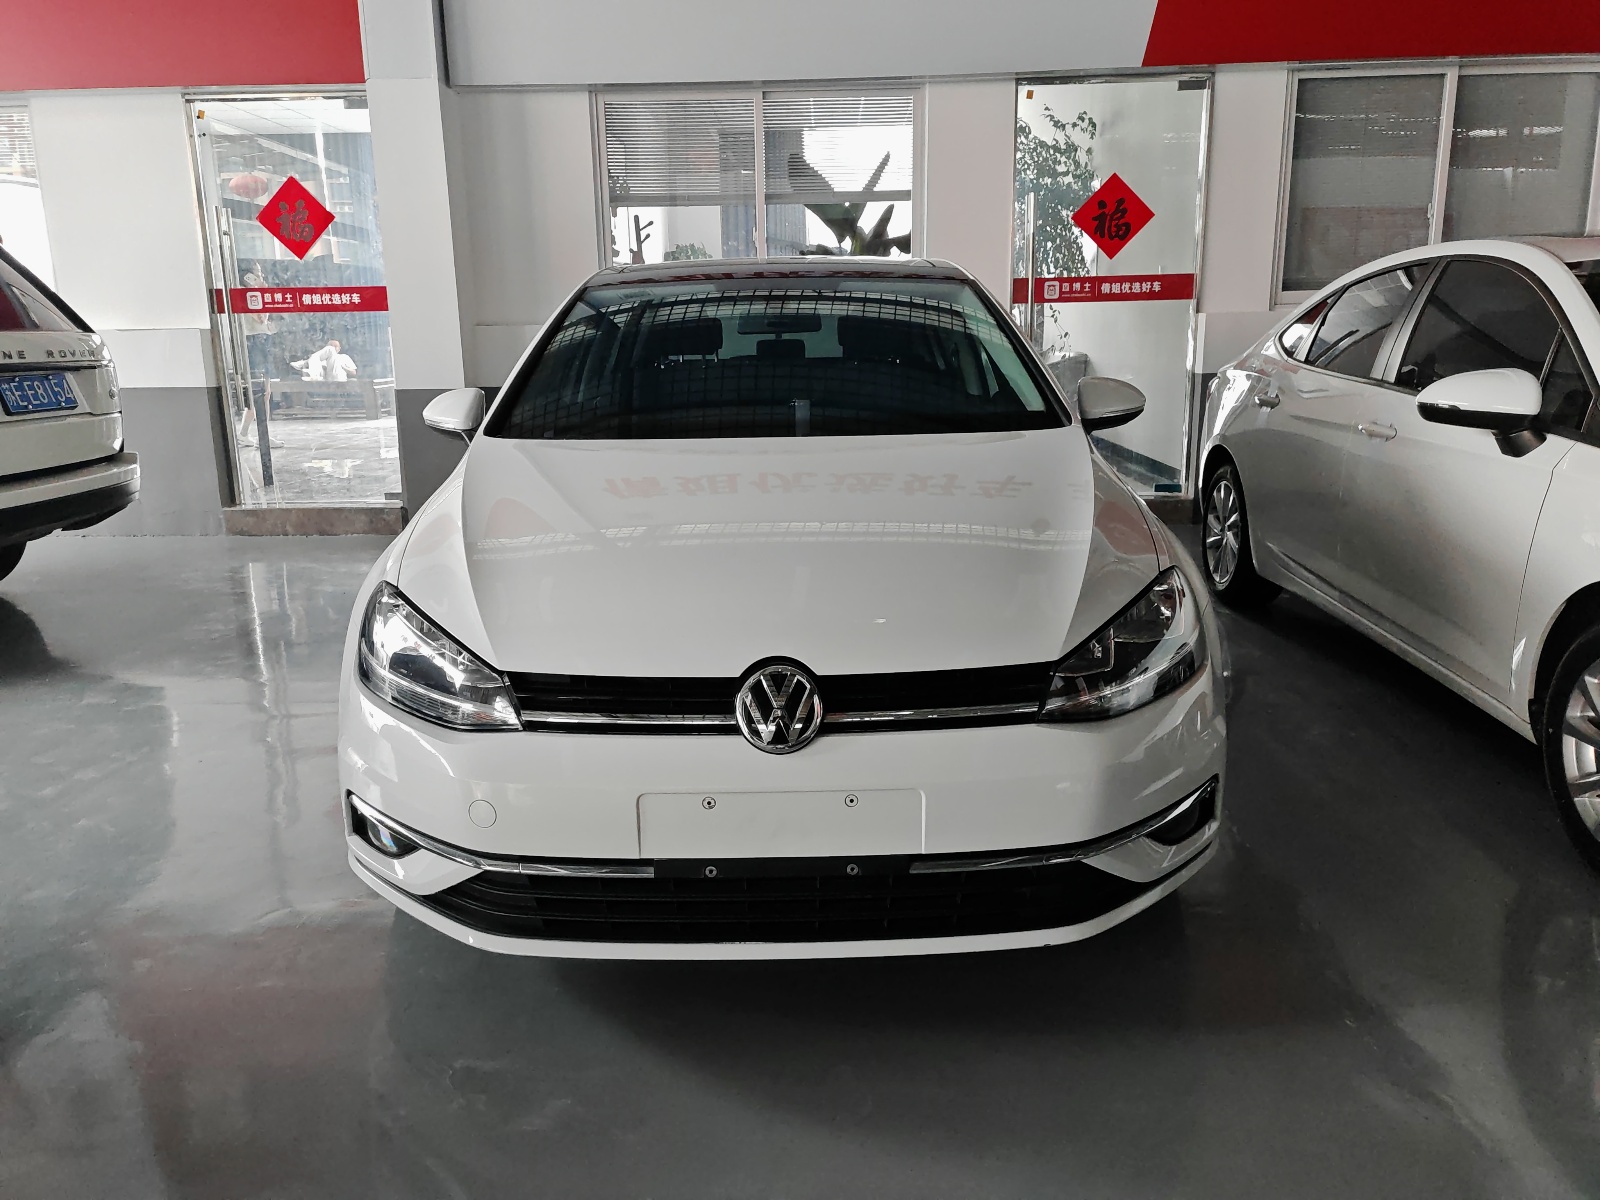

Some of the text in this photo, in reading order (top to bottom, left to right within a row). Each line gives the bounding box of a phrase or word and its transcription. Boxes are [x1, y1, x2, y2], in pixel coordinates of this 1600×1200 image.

[276, 199, 314, 243] 福
[1092, 197, 1131, 241] 福
[46, 349, 96, 359] ROVER
